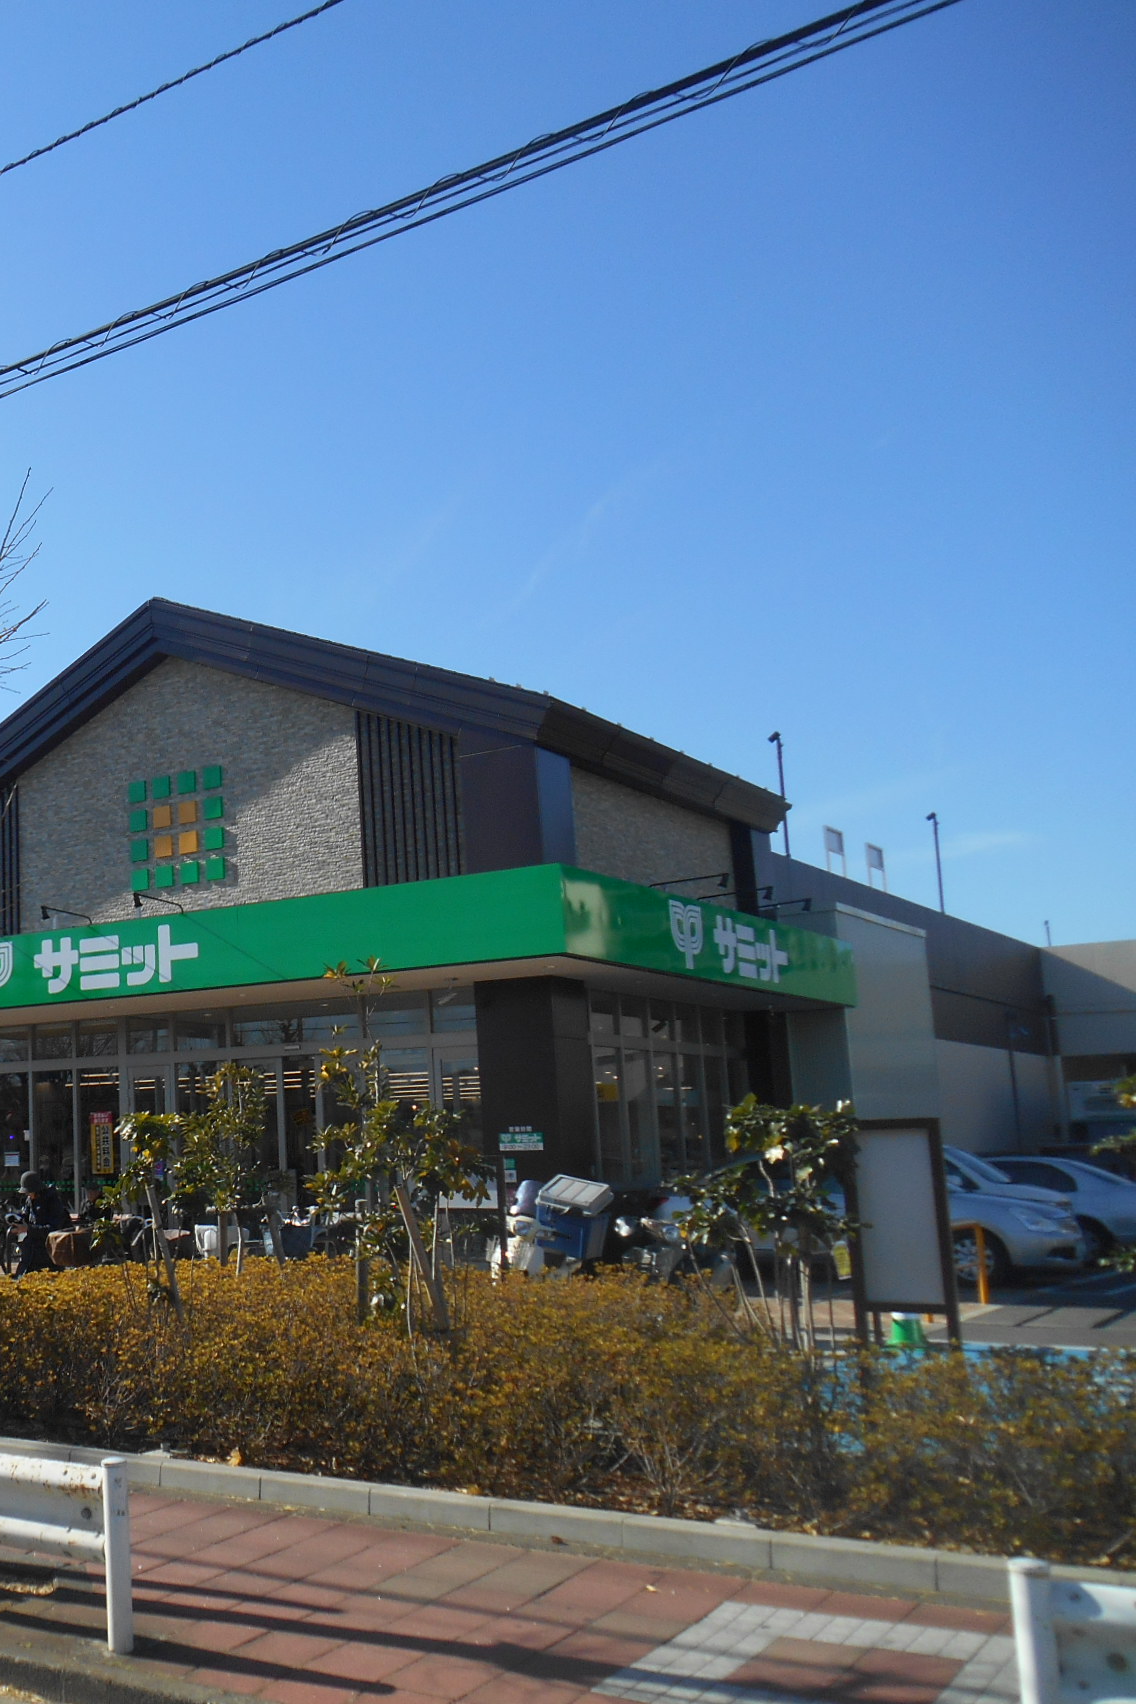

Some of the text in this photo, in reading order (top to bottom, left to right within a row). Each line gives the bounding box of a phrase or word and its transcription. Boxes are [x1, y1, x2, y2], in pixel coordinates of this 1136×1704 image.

[34, 924, 199, 994] サミット
[714, 915, 788, 983] サミット
